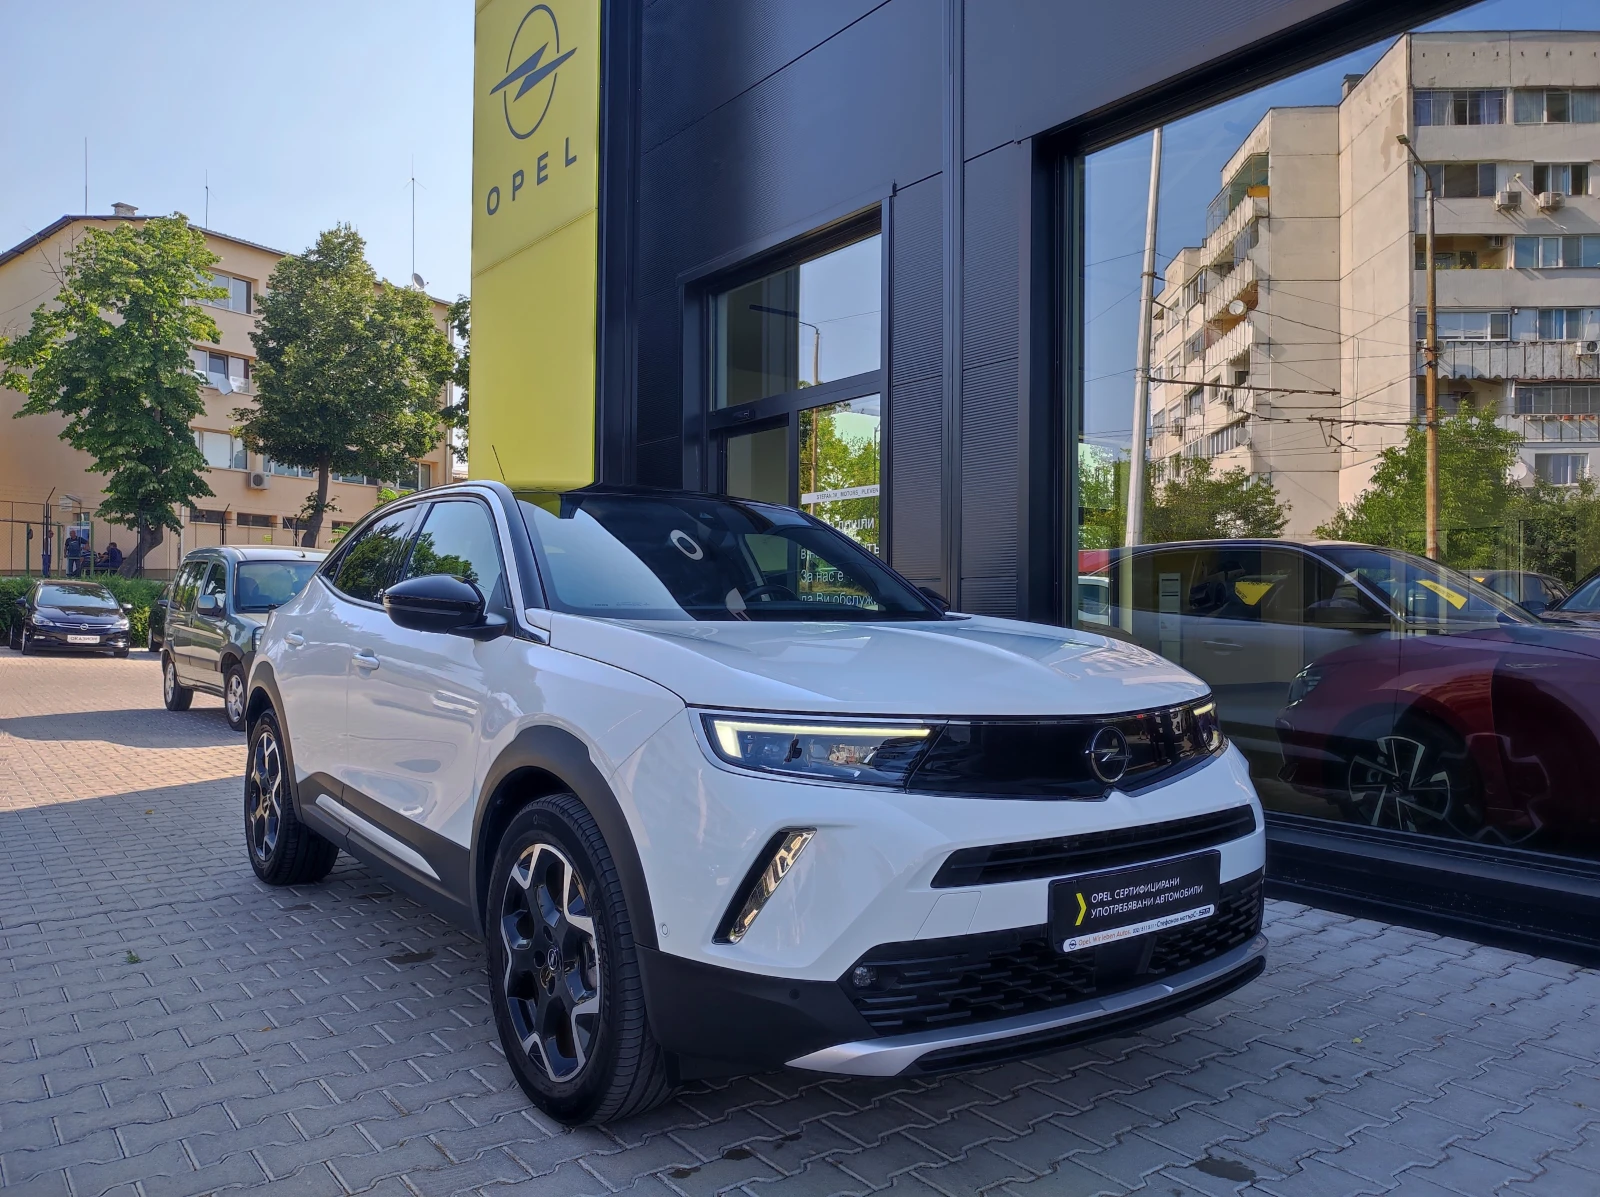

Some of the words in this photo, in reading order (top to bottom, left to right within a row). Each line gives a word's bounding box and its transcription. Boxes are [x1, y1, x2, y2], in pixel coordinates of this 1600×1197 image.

[486, 137, 578, 216] OPEL
[801, 569, 813, 583] За
[816, 571, 835, 583] нас
[837, 571, 844, 582] е
[1090, 898, 1153, 918] УПОТРЕБЯВАНИ
[1154, 884, 1204, 905] АВТОМОБИЛИ
[1091, 892, 1113, 904] OPEL
[1114, 876, 1180, 899] СЕРТИФИЦИРАНИ
